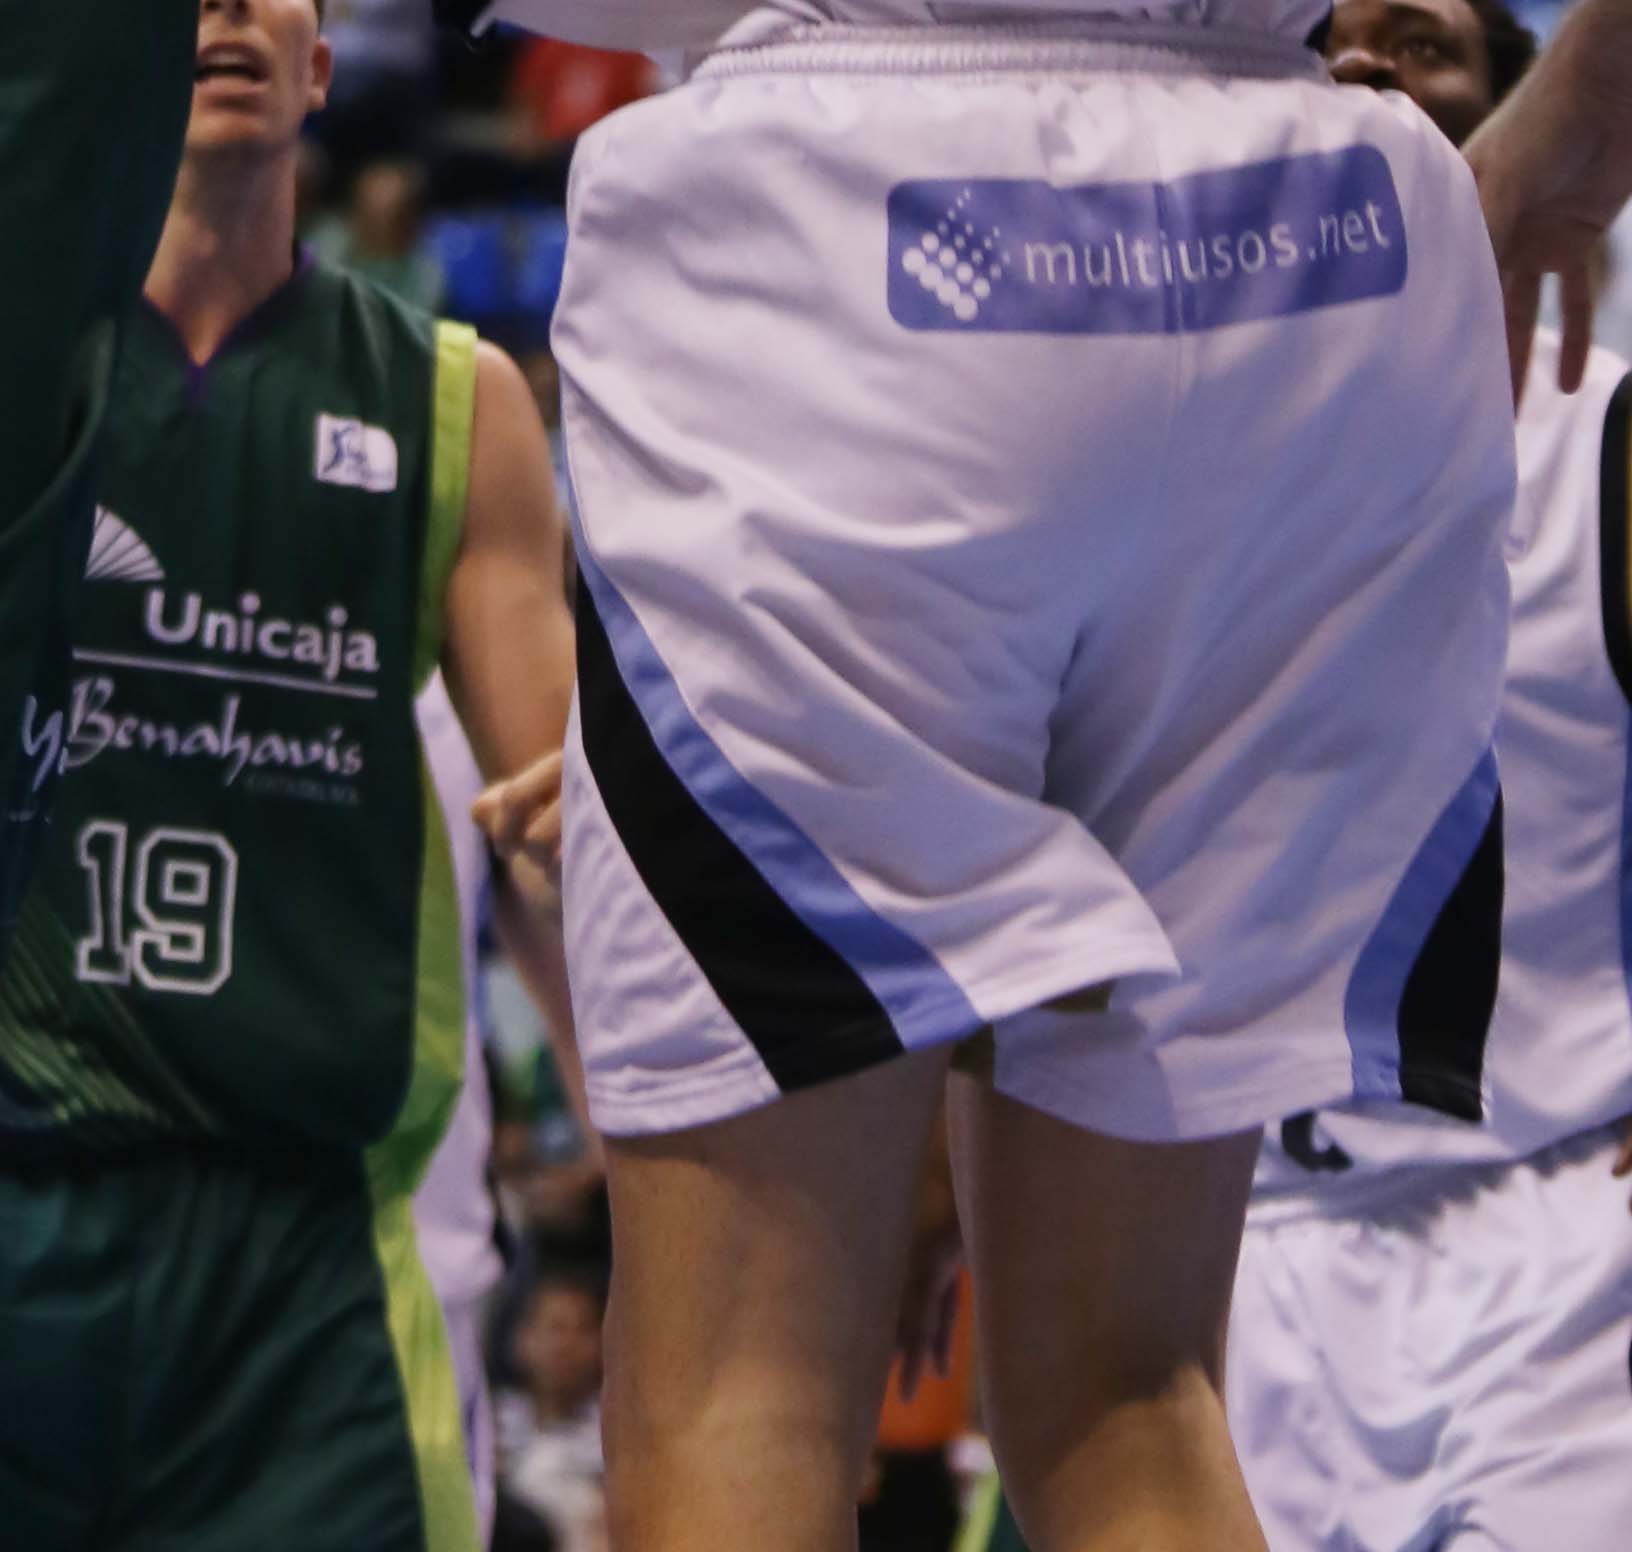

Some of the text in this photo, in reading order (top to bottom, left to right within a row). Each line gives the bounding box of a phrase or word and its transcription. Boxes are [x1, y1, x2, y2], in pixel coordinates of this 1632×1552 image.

[1024, 199, 1390, 289] multiusos.net
[145, 589, 379, 675] Unicaja
[76, 820, 239, 995] 19
